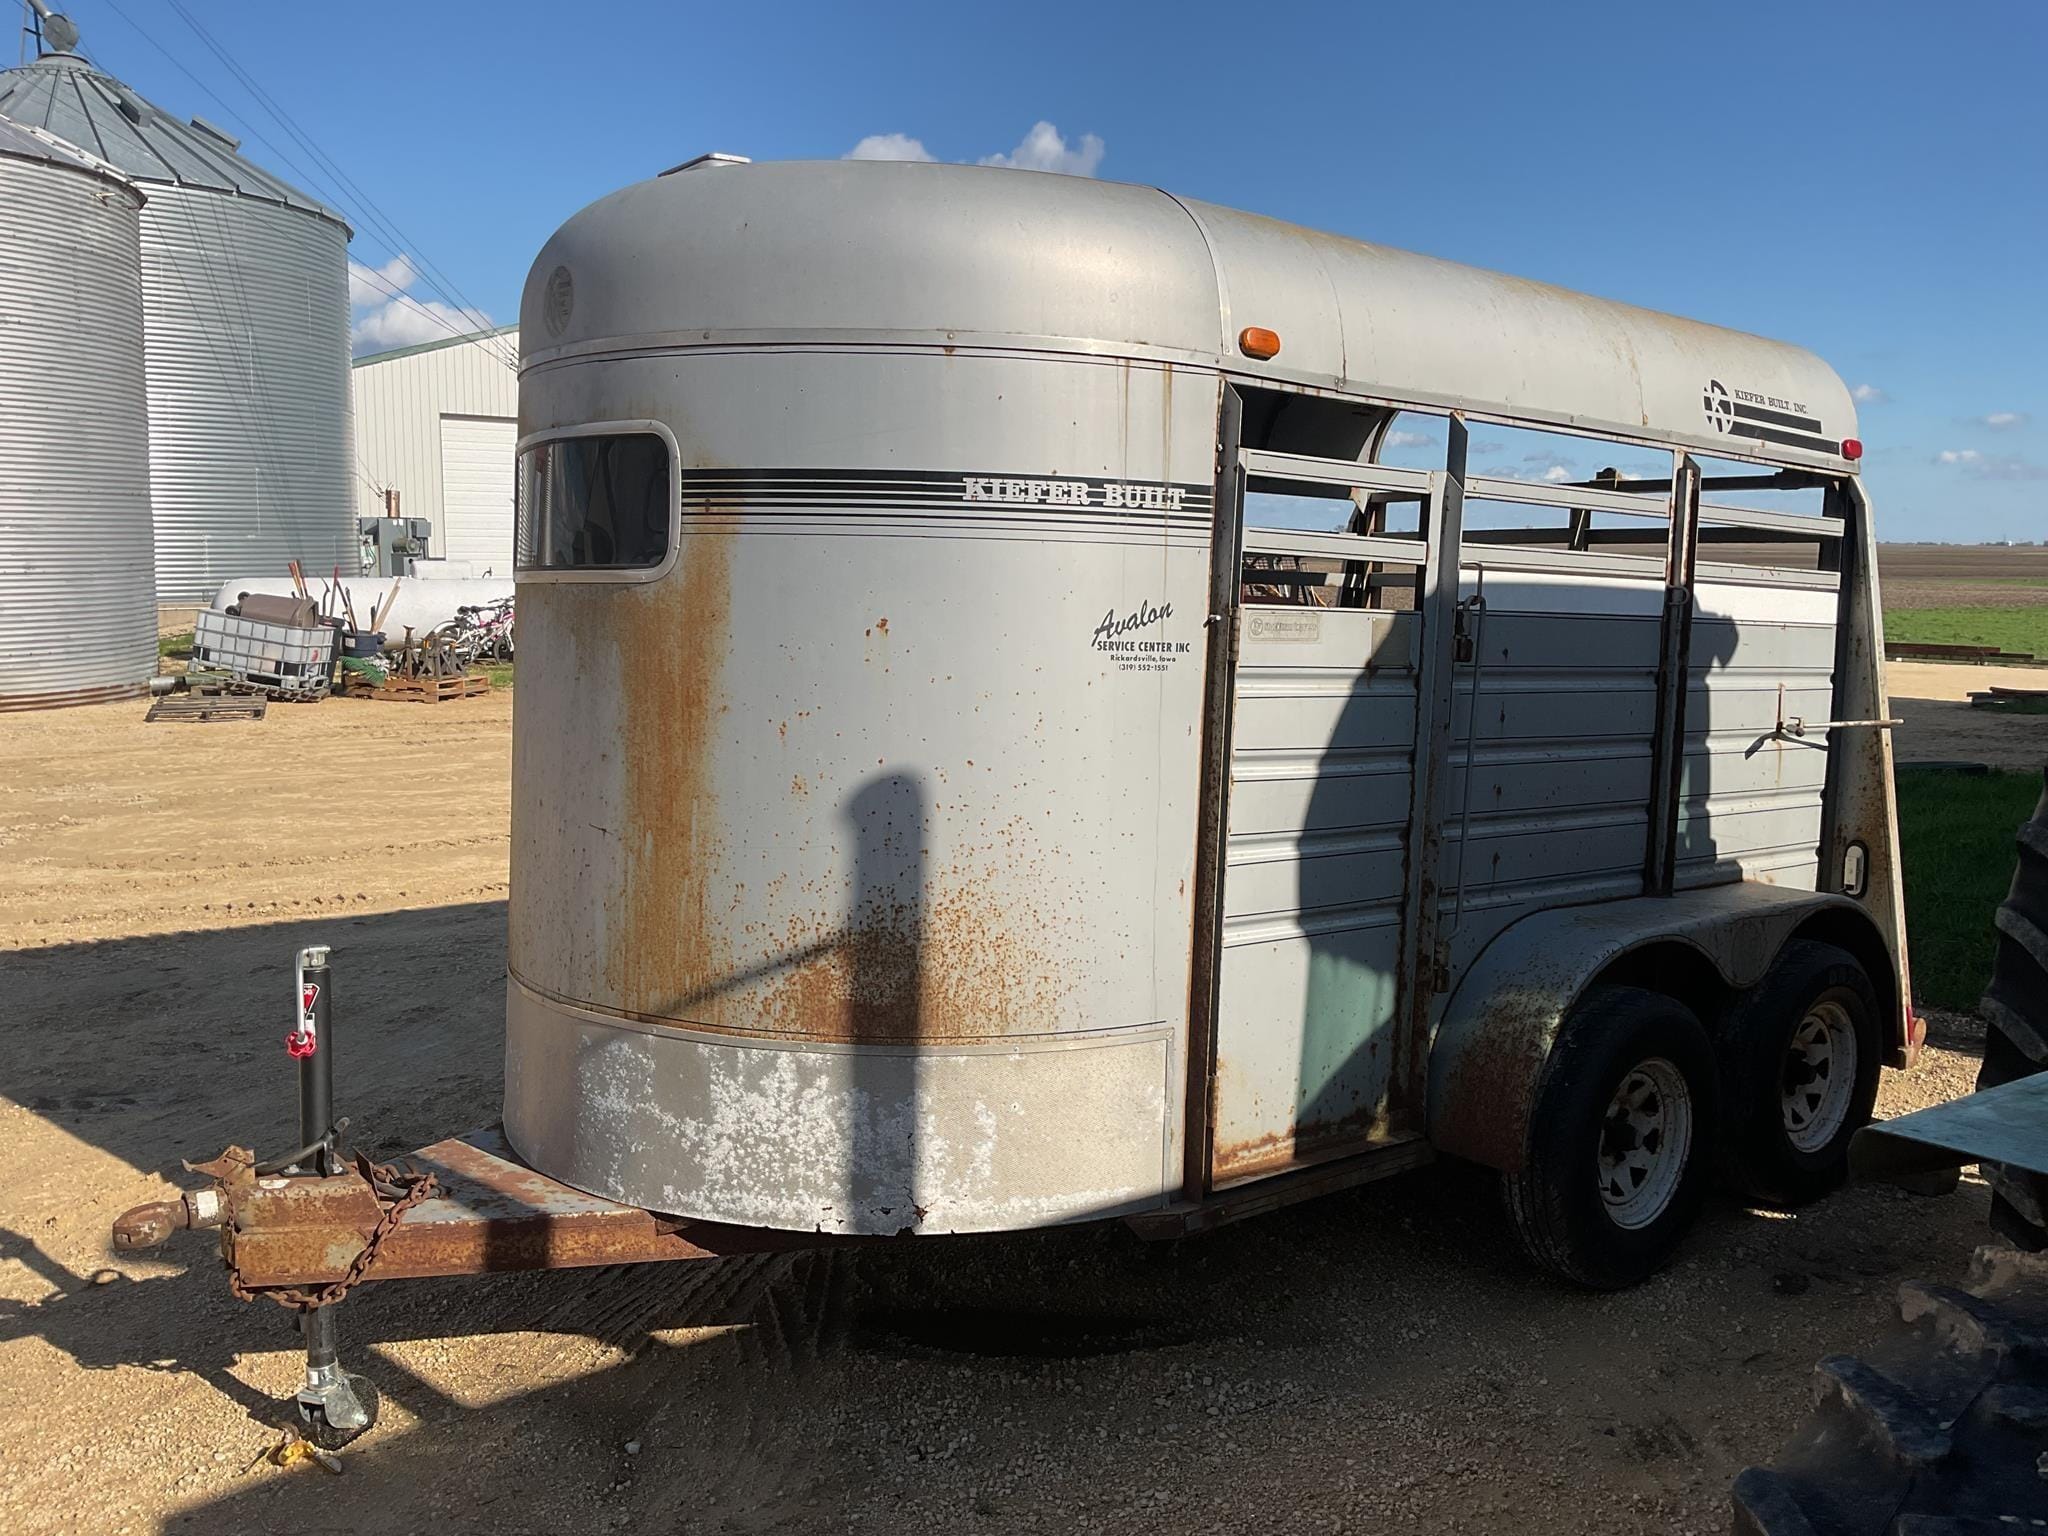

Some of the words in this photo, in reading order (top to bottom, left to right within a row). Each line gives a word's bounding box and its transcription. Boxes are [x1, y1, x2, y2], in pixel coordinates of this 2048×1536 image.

[1734, 389, 1766, 405] KIEFER
[962, 477, 1092, 506] KIEFER
[1102, 483, 1186, 510] BUILT
[1091, 599, 1174, 647] Avalon
[1097, 640, 1135, 652] SERVICE
[1138, 641, 1172, 652] CENTER
[1175, 642, 1190, 653] INC
[1159, 655, 1176, 663] Iowa
[1118, 663, 1136, 671] (319)
